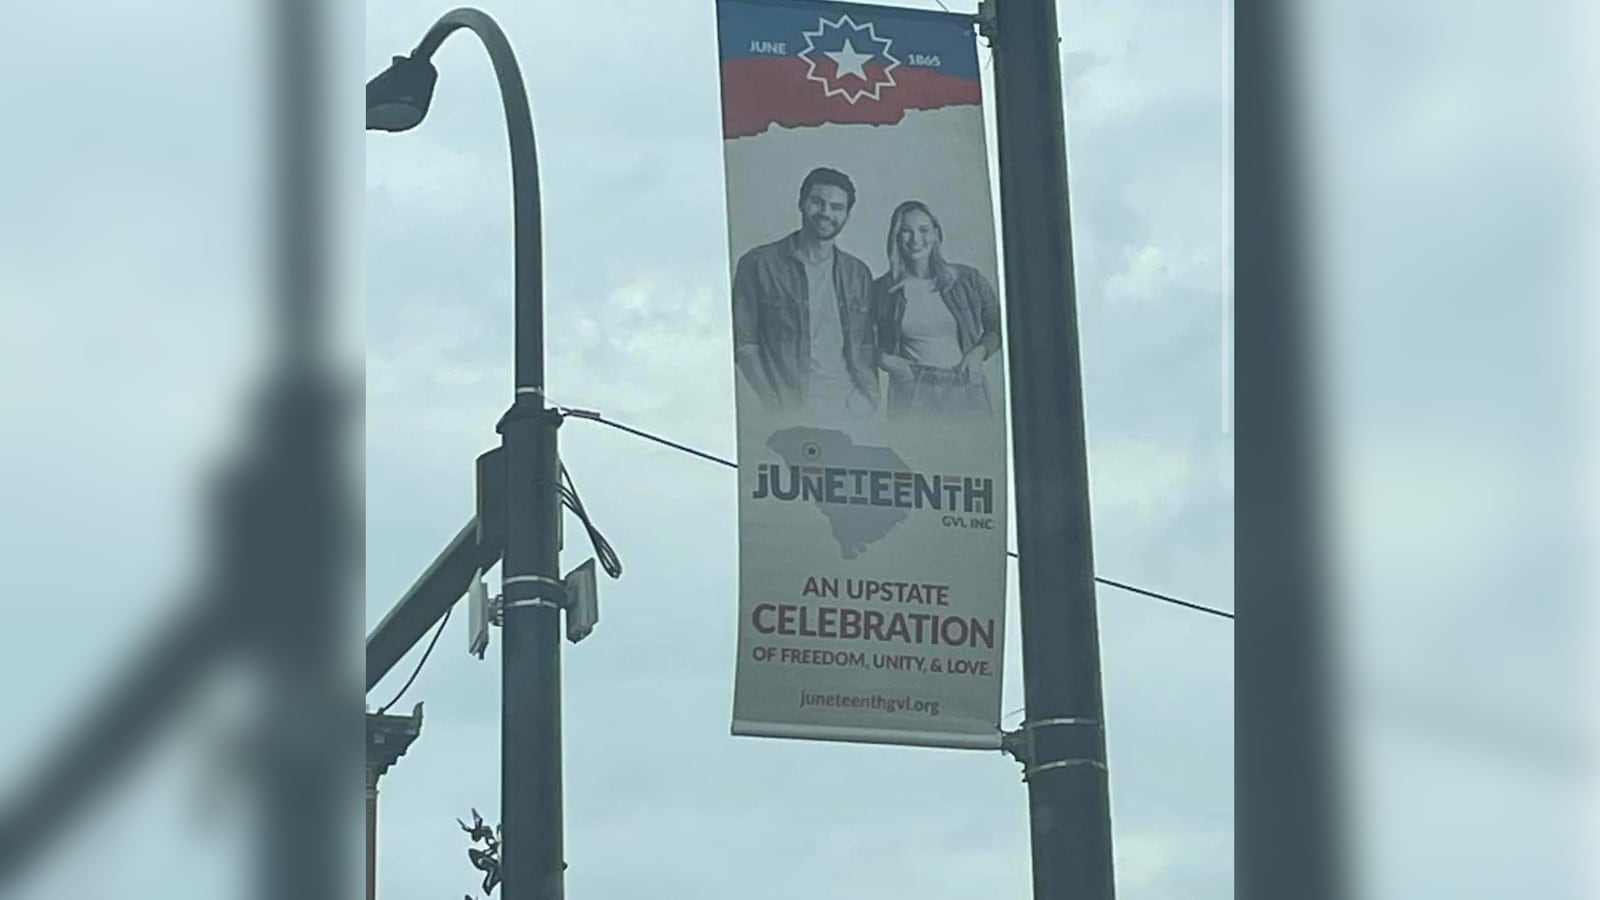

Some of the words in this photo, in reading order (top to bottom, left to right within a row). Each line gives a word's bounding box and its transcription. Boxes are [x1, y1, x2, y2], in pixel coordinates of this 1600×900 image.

[750, 40, 786, 56] JUNE
[908, 54, 941, 67] 1865
[942, 515, 967, 529] GVL
[802, 576, 839, 599] AN
[846, 579, 949, 606] UPSTATE
[752, 603, 995, 649] CELEBRATION
[752, 646, 777, 662] OF
[781, 648, 870, 671] FREEDOM,
[873, 654, 927, 674] UNITY,
[930, 658, 942, 673] &
[947, 660, 992, 676] LOVE.
[800, 689, 940, 716] juneteenthgvl.org
